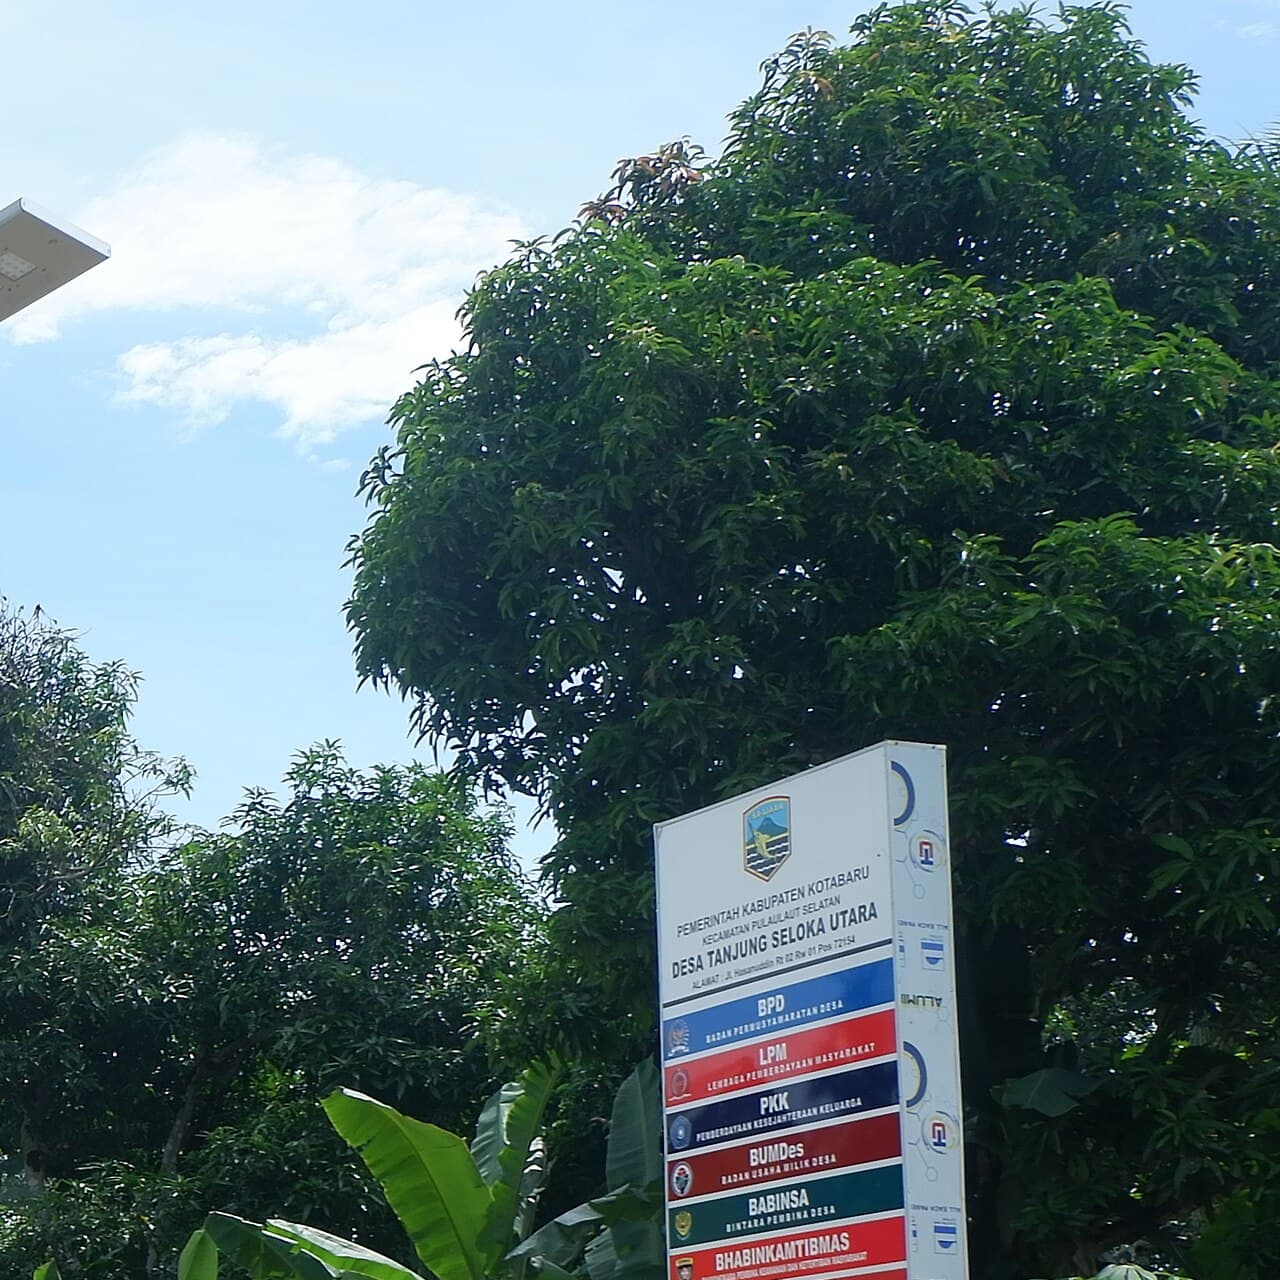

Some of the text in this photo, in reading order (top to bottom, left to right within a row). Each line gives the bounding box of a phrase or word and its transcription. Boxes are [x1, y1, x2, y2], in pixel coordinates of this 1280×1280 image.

[677, 866, 869, 938] PEMERINTAH KABUPATEN KOTABARU
[703, 922, 749, 946] KECAMATAN
[802, 896, 840, 915] SELATAN
[672, 902, 878, 979] DESA TANJUNG SELOKA UTARA
[706, 1029, 733, 1044] BADAN
[820, 999, 844, 1013] DESA
[758, 994, 785, 1017] BPD
[707, 1042, 876, 1091] LEMBAGA PEMBERDAYAAN MASYARAKAT
[759, 1042, 787, 1066] LPM
[754, 1107, 818, 1131] KESEJAHTERAAN
[819, 1097, 862, 1114] KELUARGA
[760, 1092, 789, 1115] PKK
[721, 1154, 836, 1185] BADAN USAHA MILIK DESA
[749, 1142, 805, 1167] BUMDes
[749, 1188, 810, 1216] BABINSA
[726, 1205, 836, 1233] BINTARA PEMBINA DESA
[715, 1232, 850, 1271] BHABINKAMTIBMAS
